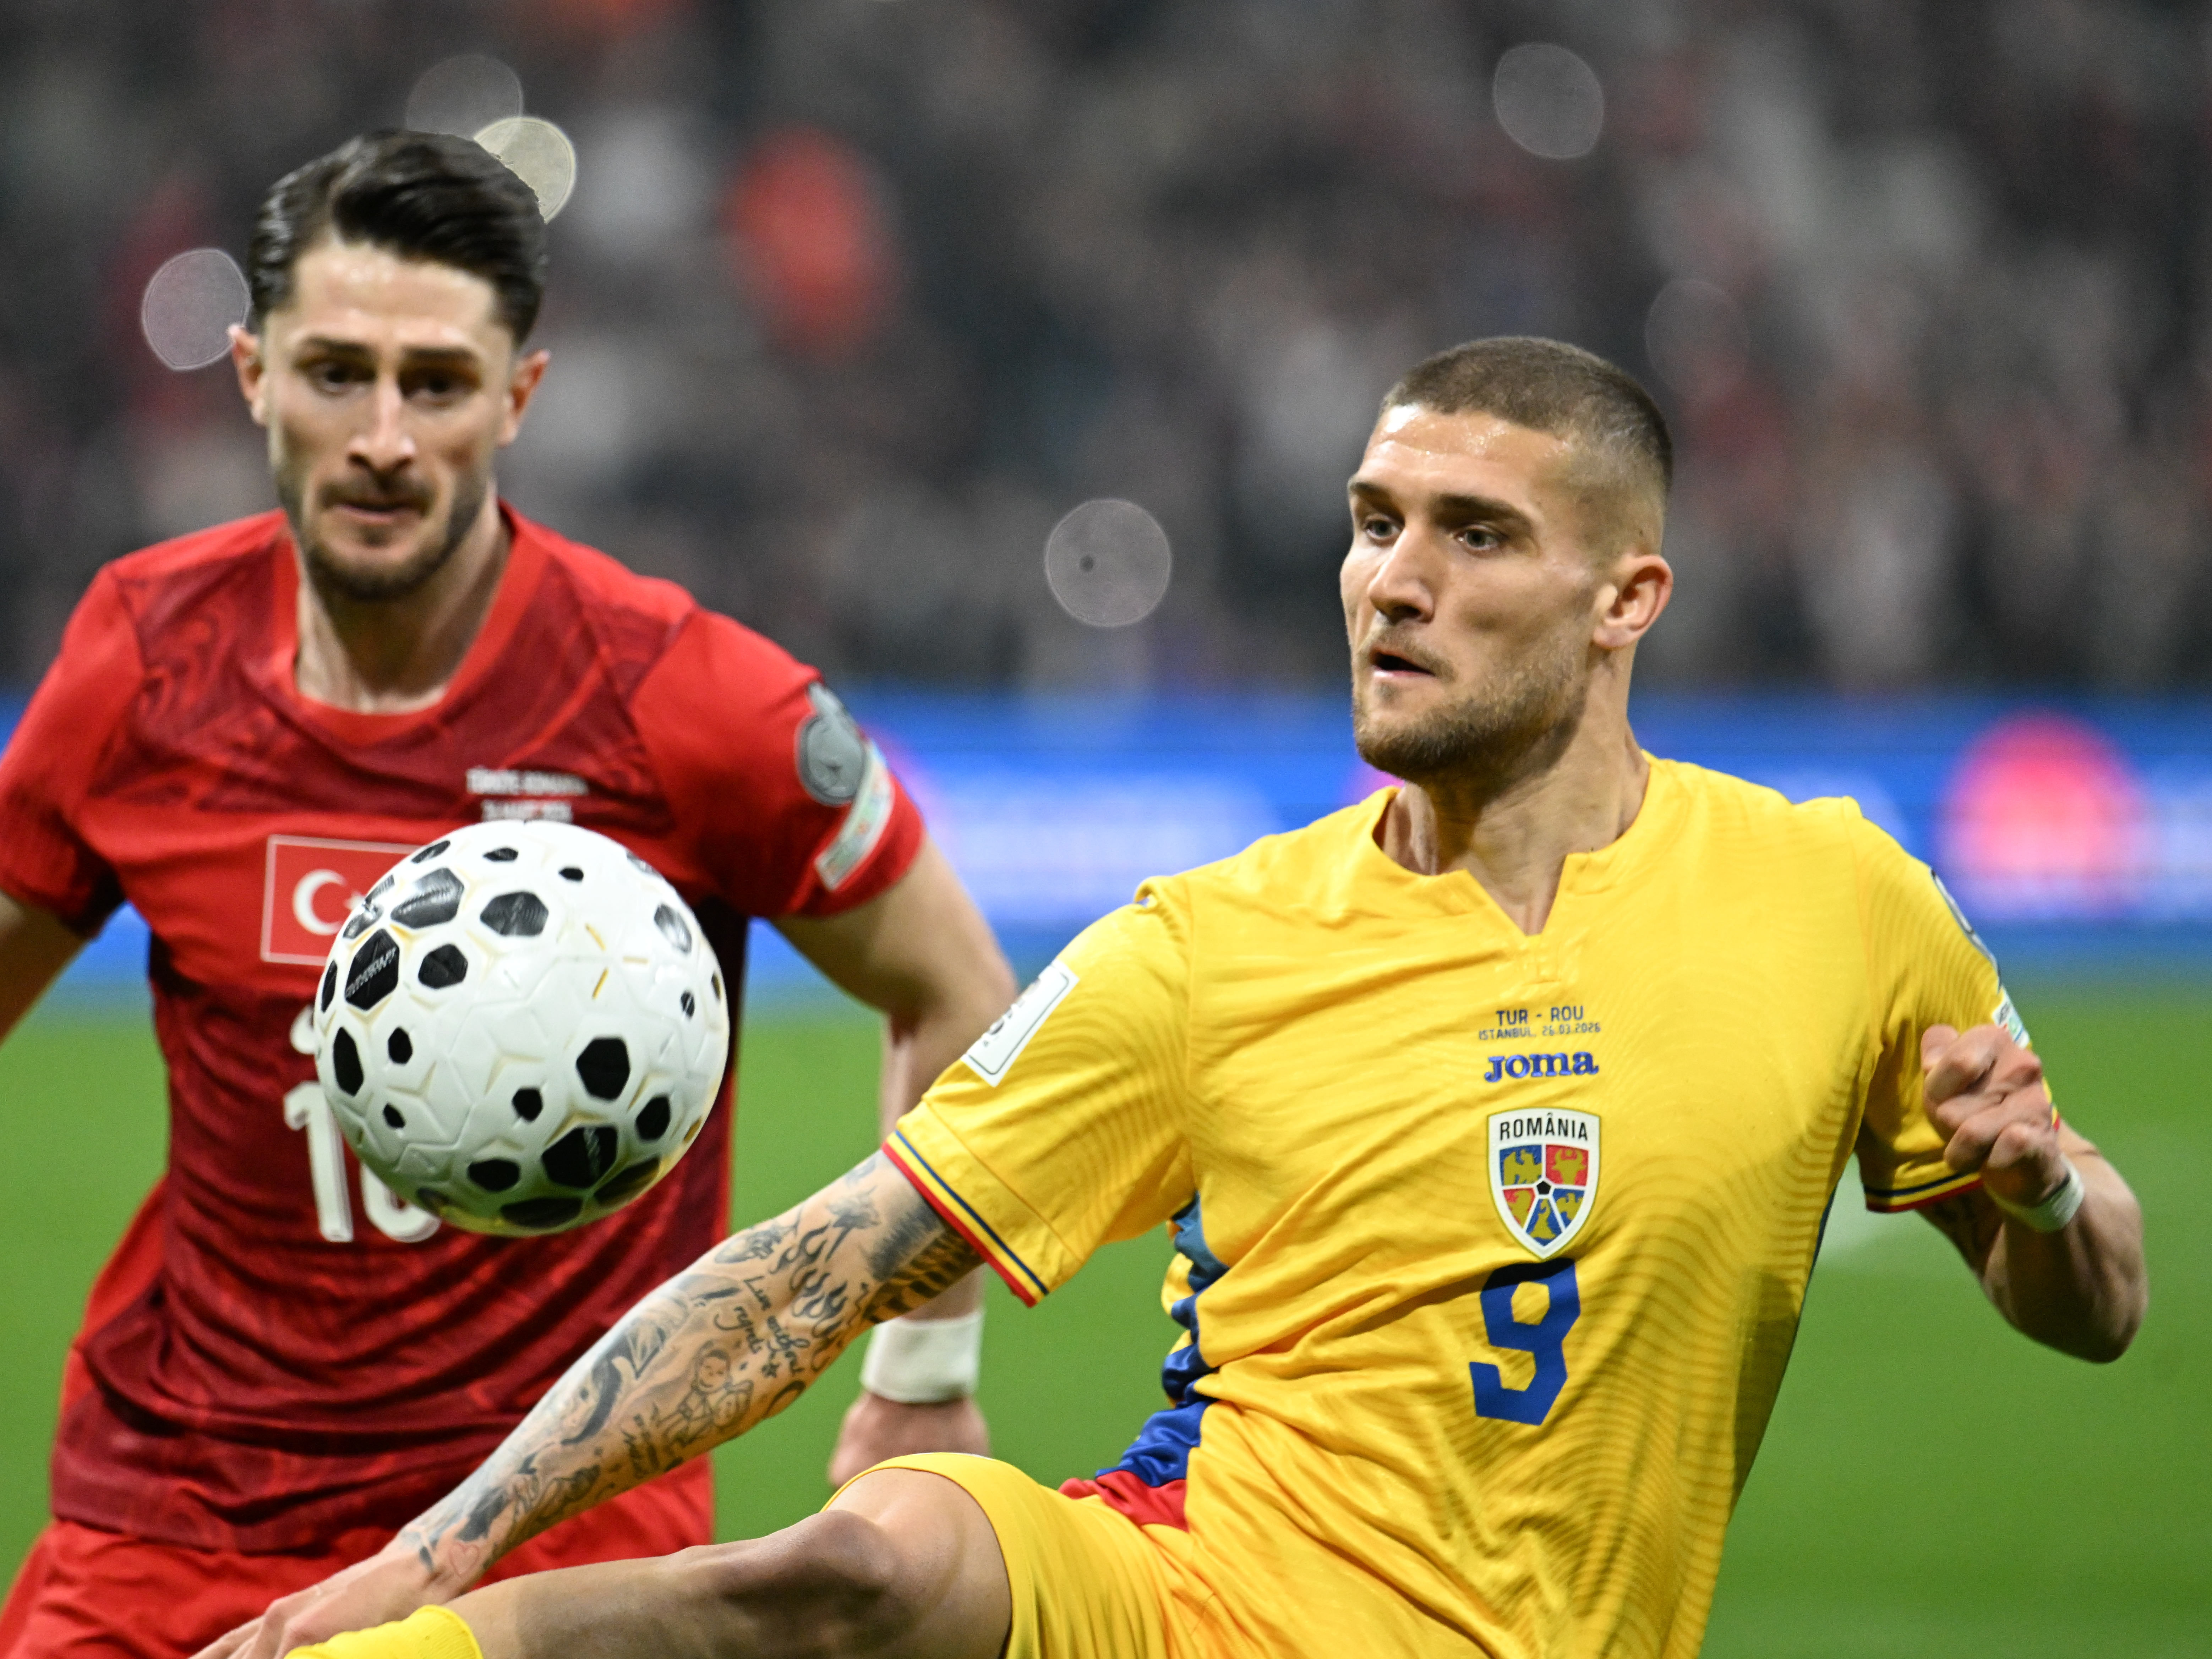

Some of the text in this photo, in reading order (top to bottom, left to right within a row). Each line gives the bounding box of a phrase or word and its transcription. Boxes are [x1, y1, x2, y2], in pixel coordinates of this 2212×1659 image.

[1496, 1009, 1528, 1026] TUR
[1551, 1006, 1584, 1022] ROU
[1542, 1022, 1601, 1036] 26.03.2026
[1500, 1112, 1588, 1141] ROMÂNIA
[1469, 1257, 1582, 1427] 9
